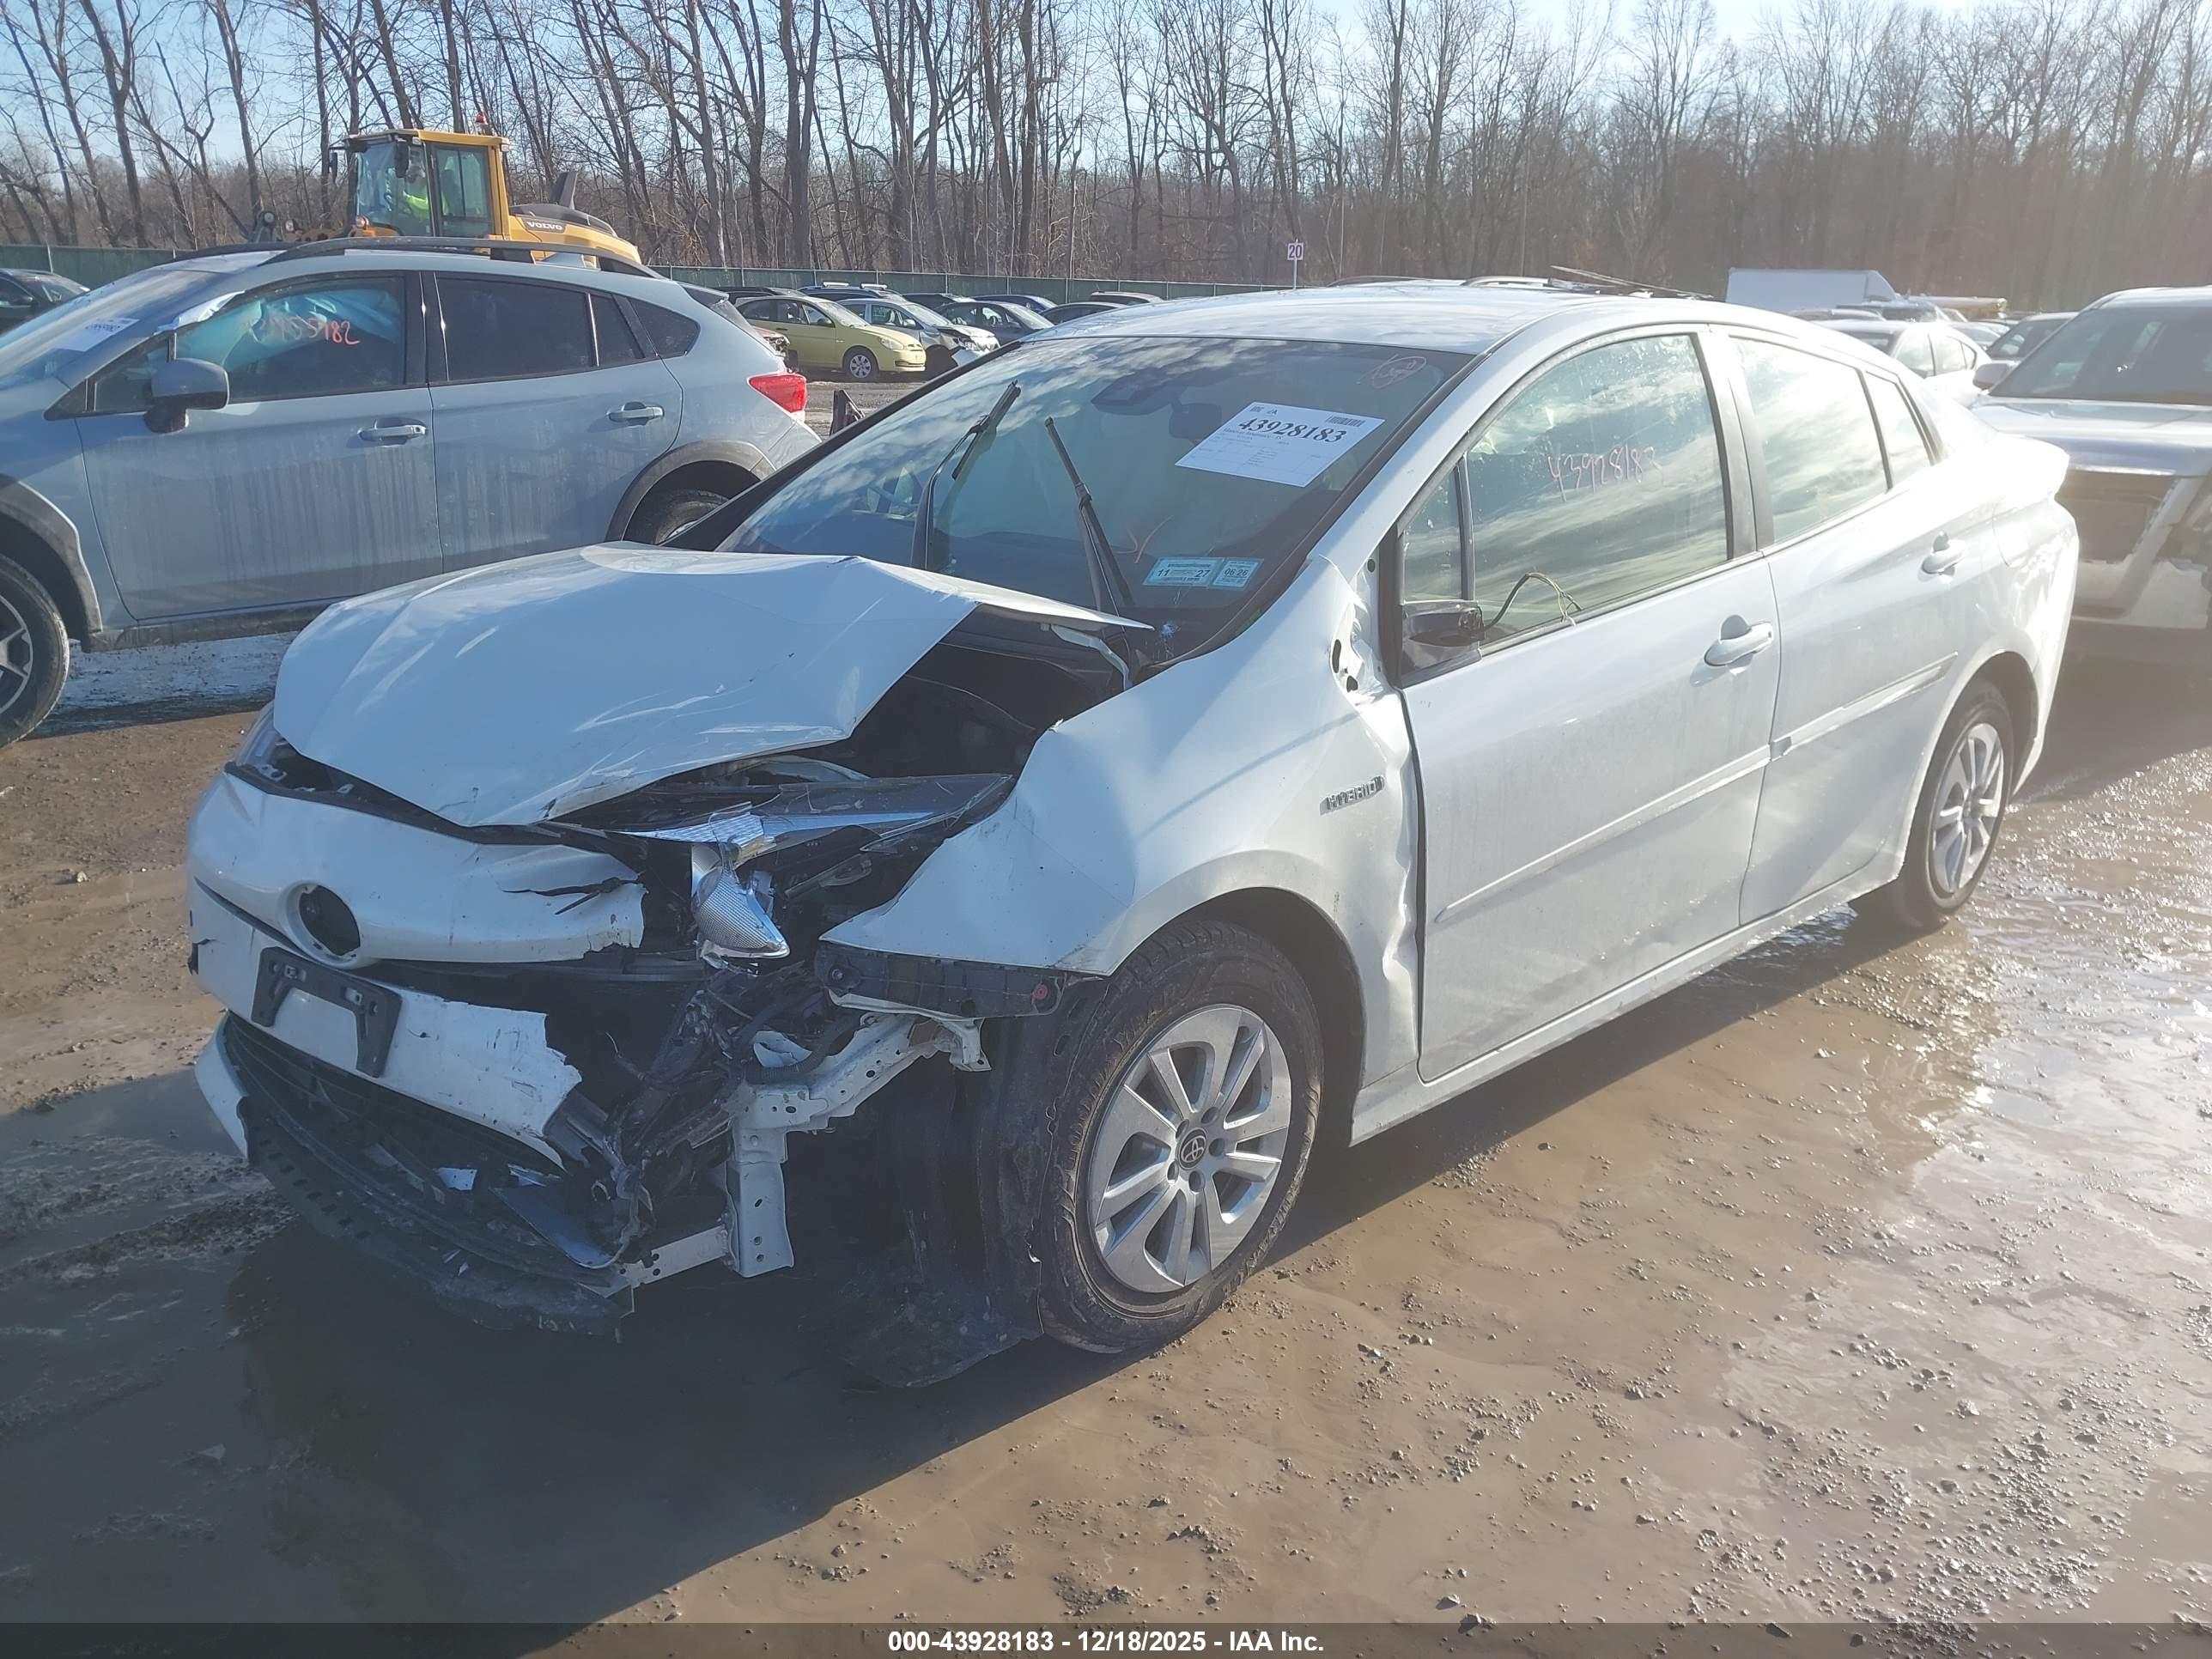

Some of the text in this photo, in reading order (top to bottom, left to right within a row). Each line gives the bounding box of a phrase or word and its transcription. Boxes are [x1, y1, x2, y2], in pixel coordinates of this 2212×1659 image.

[526, 221, 563, 230] VOLVO
[1289, 245, 1303, 258] 20
[1238, 417, 1346, 443] 43928183
[1195, 569, 1210, 578] 27
